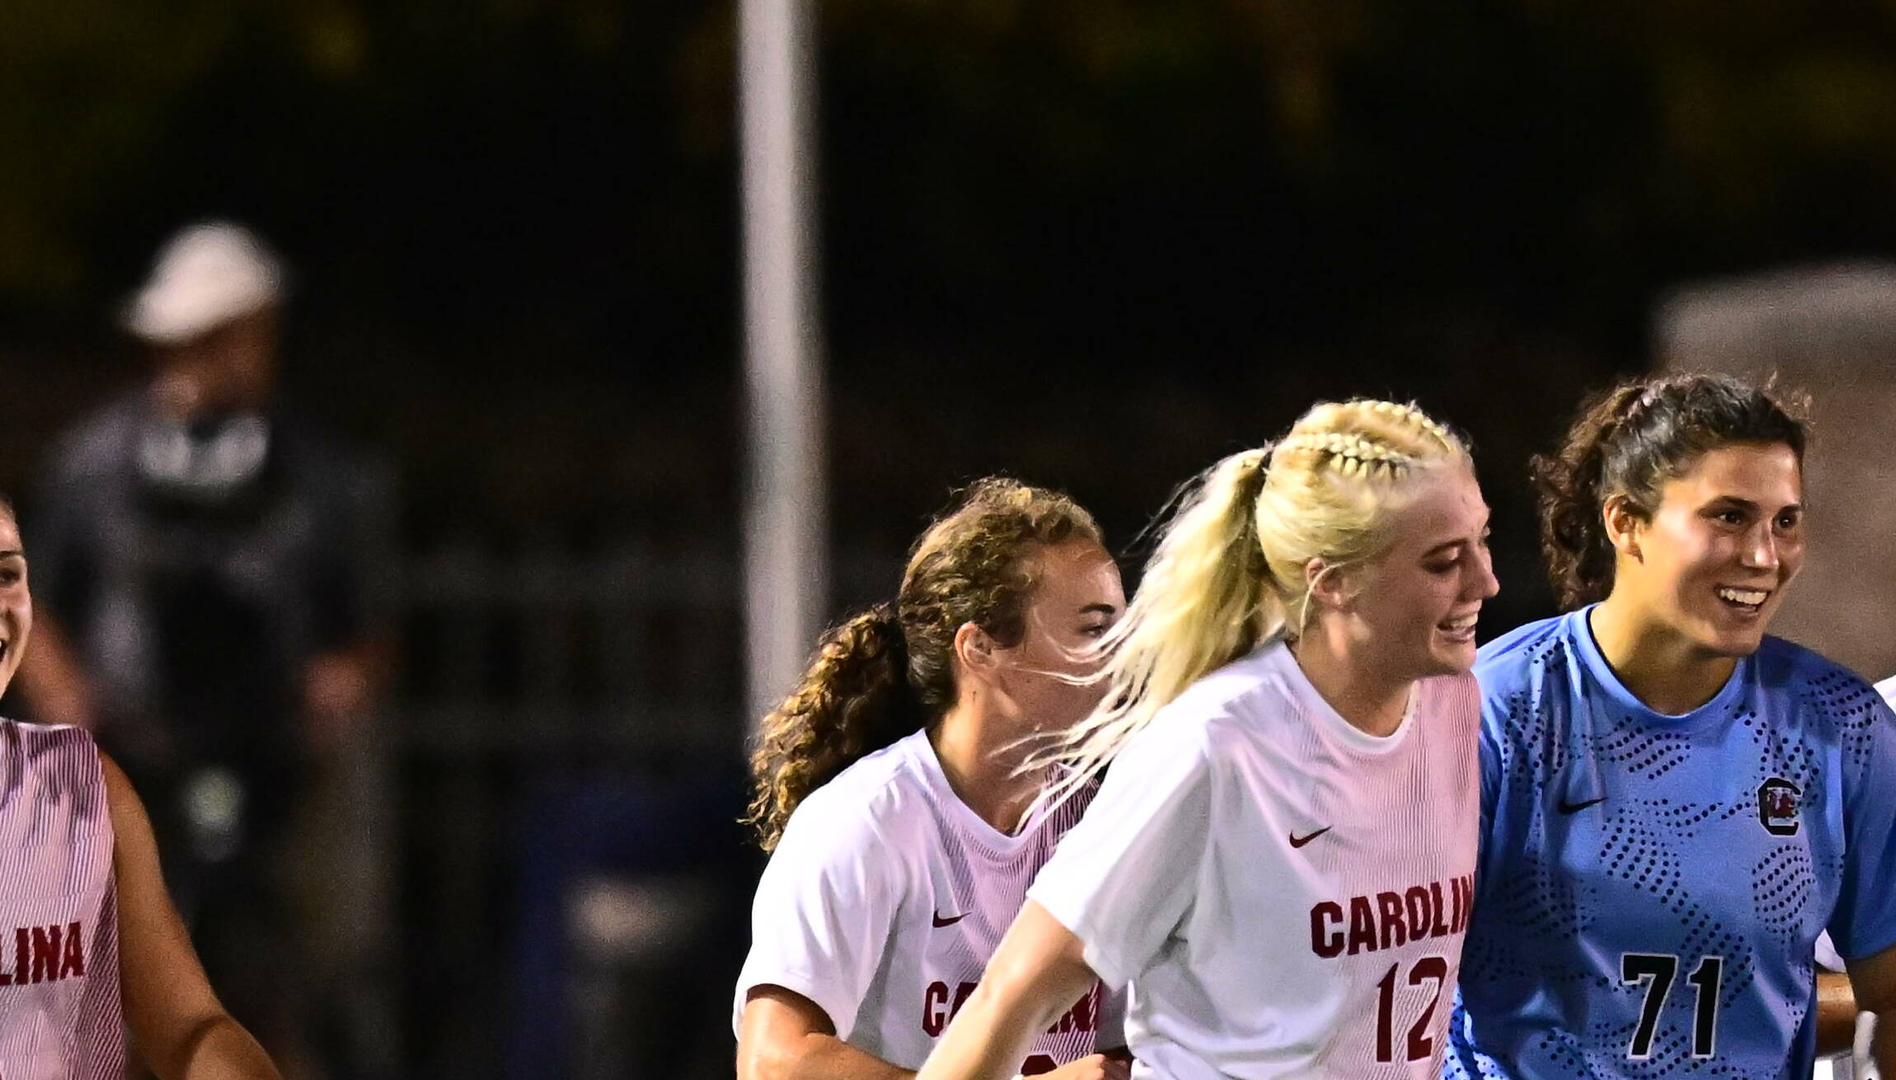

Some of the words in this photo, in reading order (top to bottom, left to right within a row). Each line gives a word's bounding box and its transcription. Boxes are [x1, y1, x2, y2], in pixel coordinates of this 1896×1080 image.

[1311, 871, 1476, 958] CAROLIN
[1377, 956, 1447, 1062] 12
[1621, 953, 1724, 1060] 71
